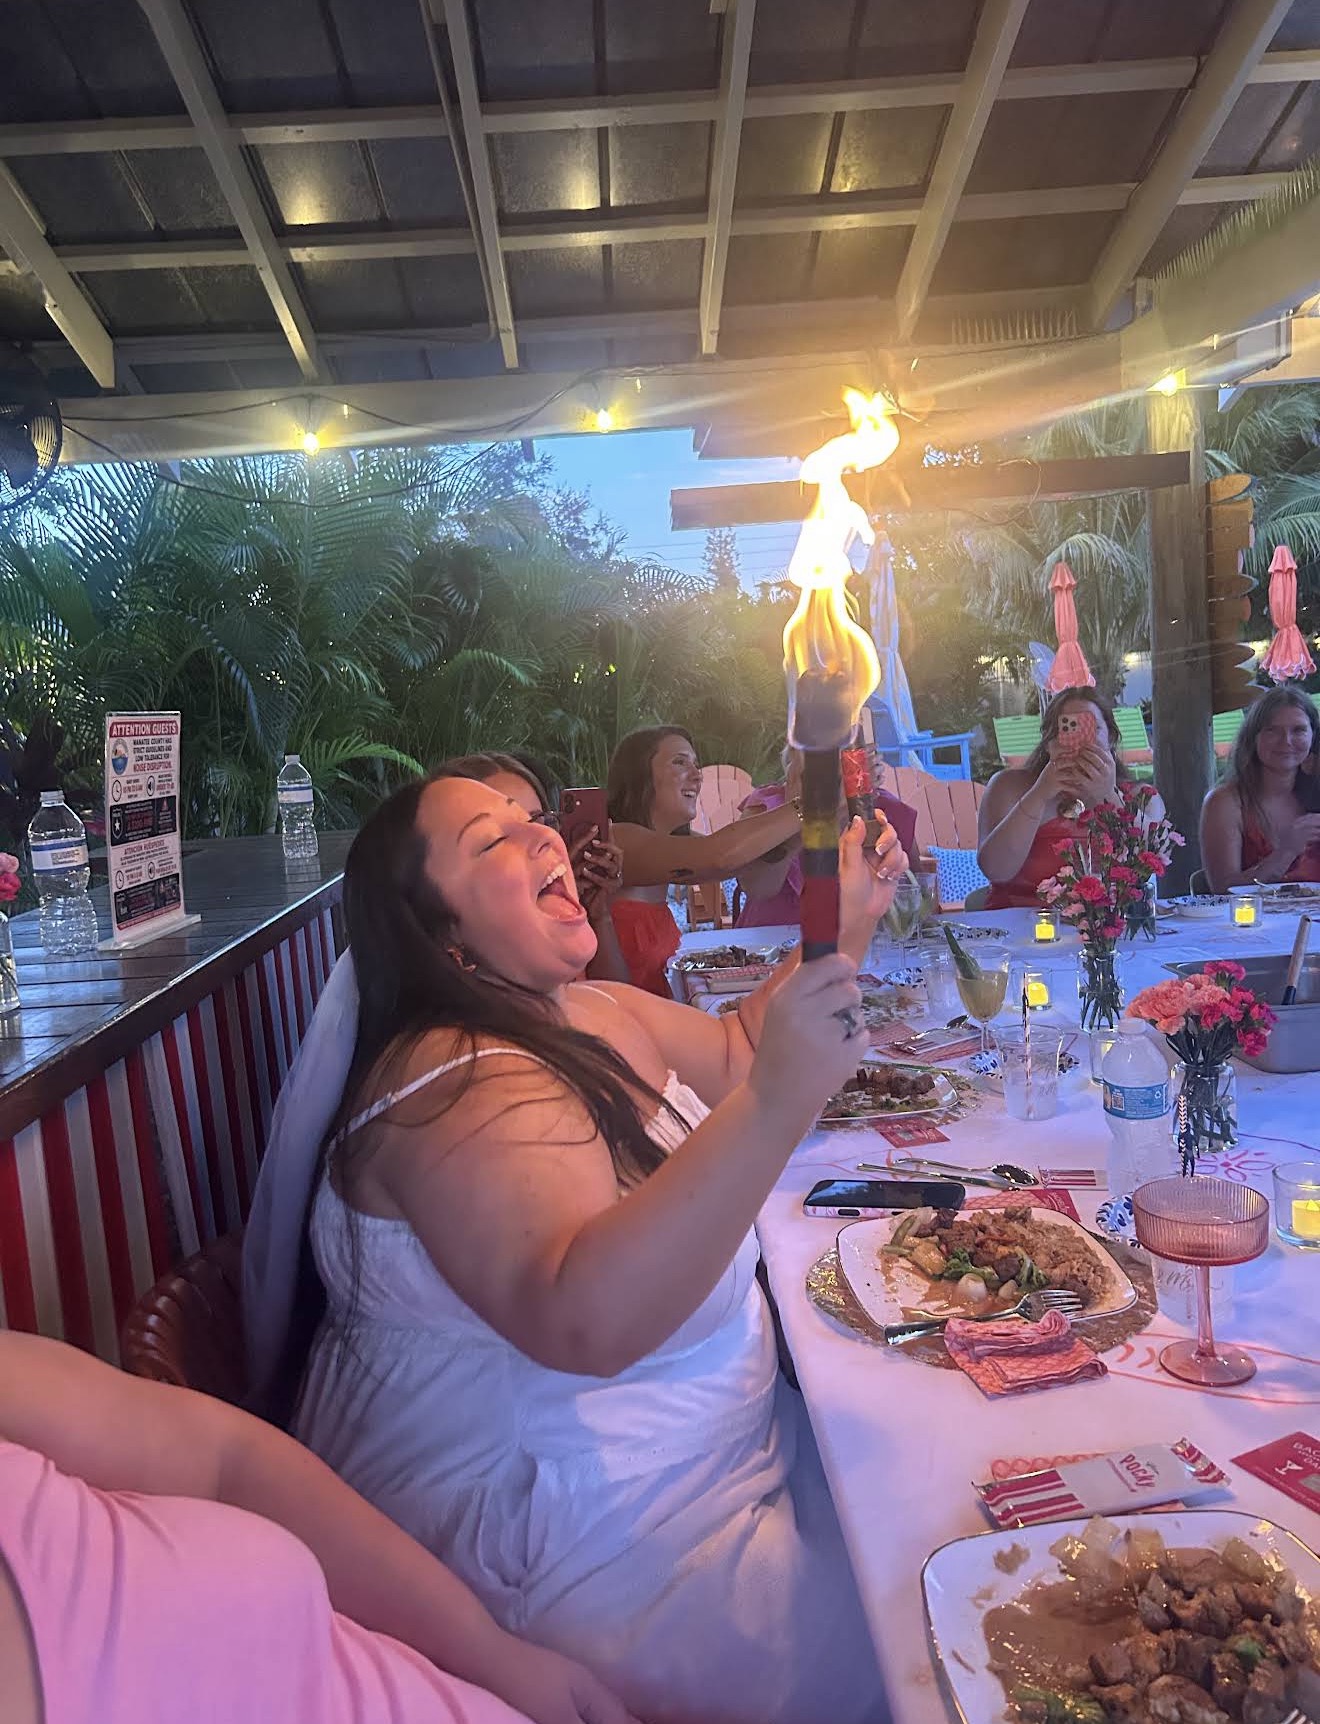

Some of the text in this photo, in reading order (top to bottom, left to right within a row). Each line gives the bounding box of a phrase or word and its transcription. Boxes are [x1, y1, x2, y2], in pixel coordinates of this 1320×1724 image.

[112, 722, 176, 736] ATTENTION GUESTS
[133, 762, 146, 772] NOISE
[1119, 1454, 1156, 1487] POCKY
